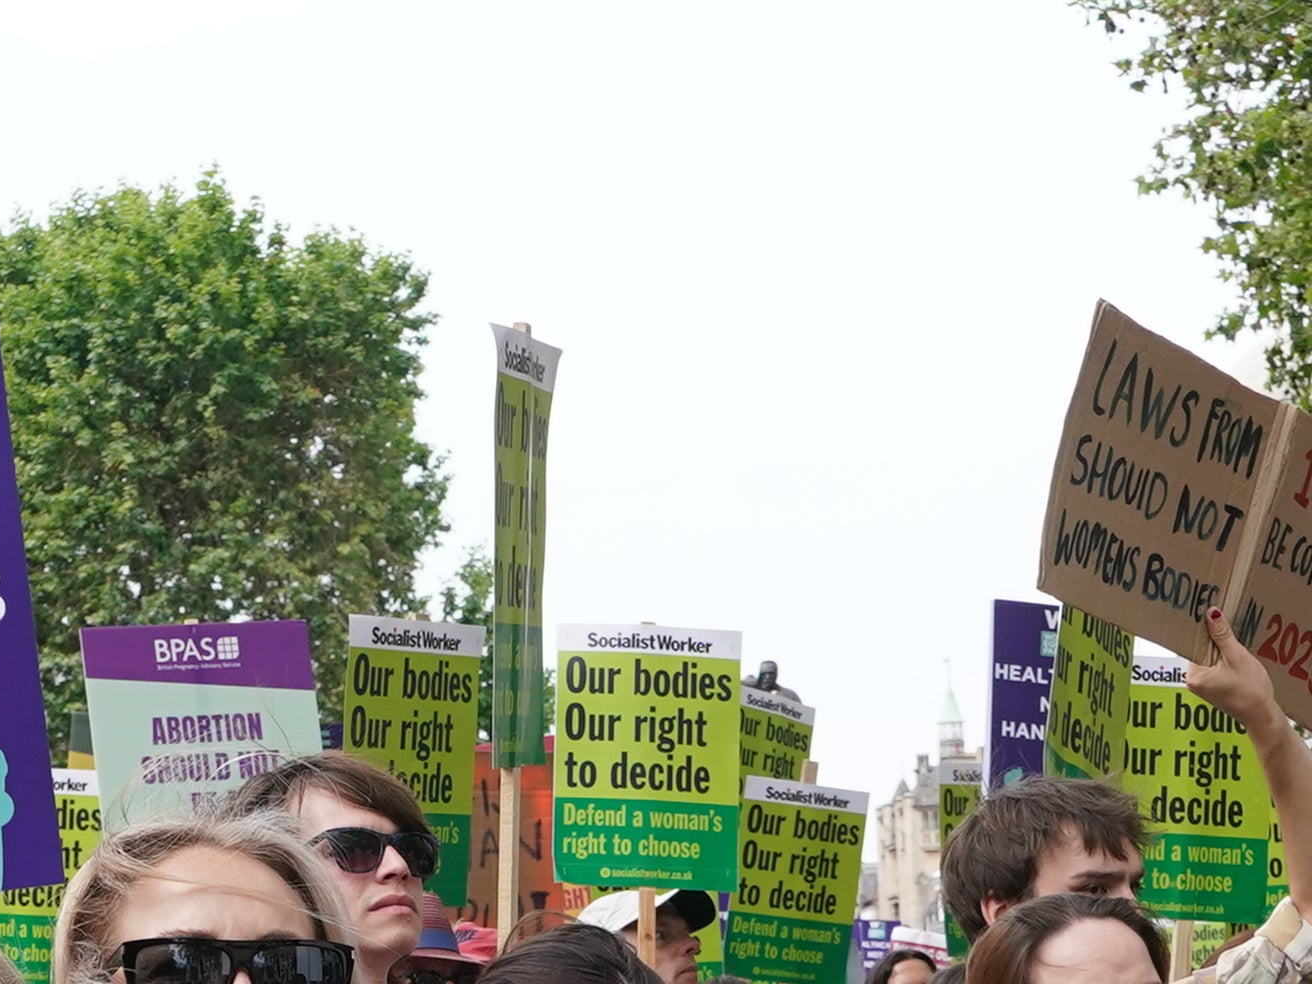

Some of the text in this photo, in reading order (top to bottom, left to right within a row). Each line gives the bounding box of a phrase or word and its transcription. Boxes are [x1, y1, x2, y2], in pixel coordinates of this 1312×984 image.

[1092, 339, 1263, 479] LAWS FROM
[1173, 484, 1245, 552] NOT
[1054, 508, 1141, 592] WOMENS
[1261, 516, 1293, 571] BE
[1239, 597, 1264, 651] IN
[154, 637, 216, 663] BPAS
[353, 652, 394, 698] Our
[402, 657, 473, 704] bodies
[566, 655, 622, 695] Our
[634, 658, 732, 702] bodies
[995, 663, 1055, 685] HEAL
[1078, 653, 1115, 718] right
[152, 712, 264, 746] ABORTION
[350, 705, 454, 762] Our right
[565, 702, 707, 753] Our right
[765, 716, 809, 752] bodies
[1126, 700, 1163, 729] ur
[740, 740, 796, 780] ur right
[1062, 701, 1111, 776] decide
[565, 752, 711, 795] to decide
[1123, 738, 1241, 788] ur right
[563, 803, 723, 833] Defend a woman's
[747, 804, 860, 846] Our bodies
[1151, 786, 1244, 829] decide
[562, 831, 701, 860] right to choose
[742, 840, 840, 883] Our right
[1171, 844, 1182, 862] a
[1188, 843, 1254, 867] woman's
[738, 877, 837, 915] to decide
[1152, 867, 1233, 894] to choose
[732, 915, 777, 937] Defend
[780, 925, 788, 938] a
[729, 938, 823, 964] right to choose
